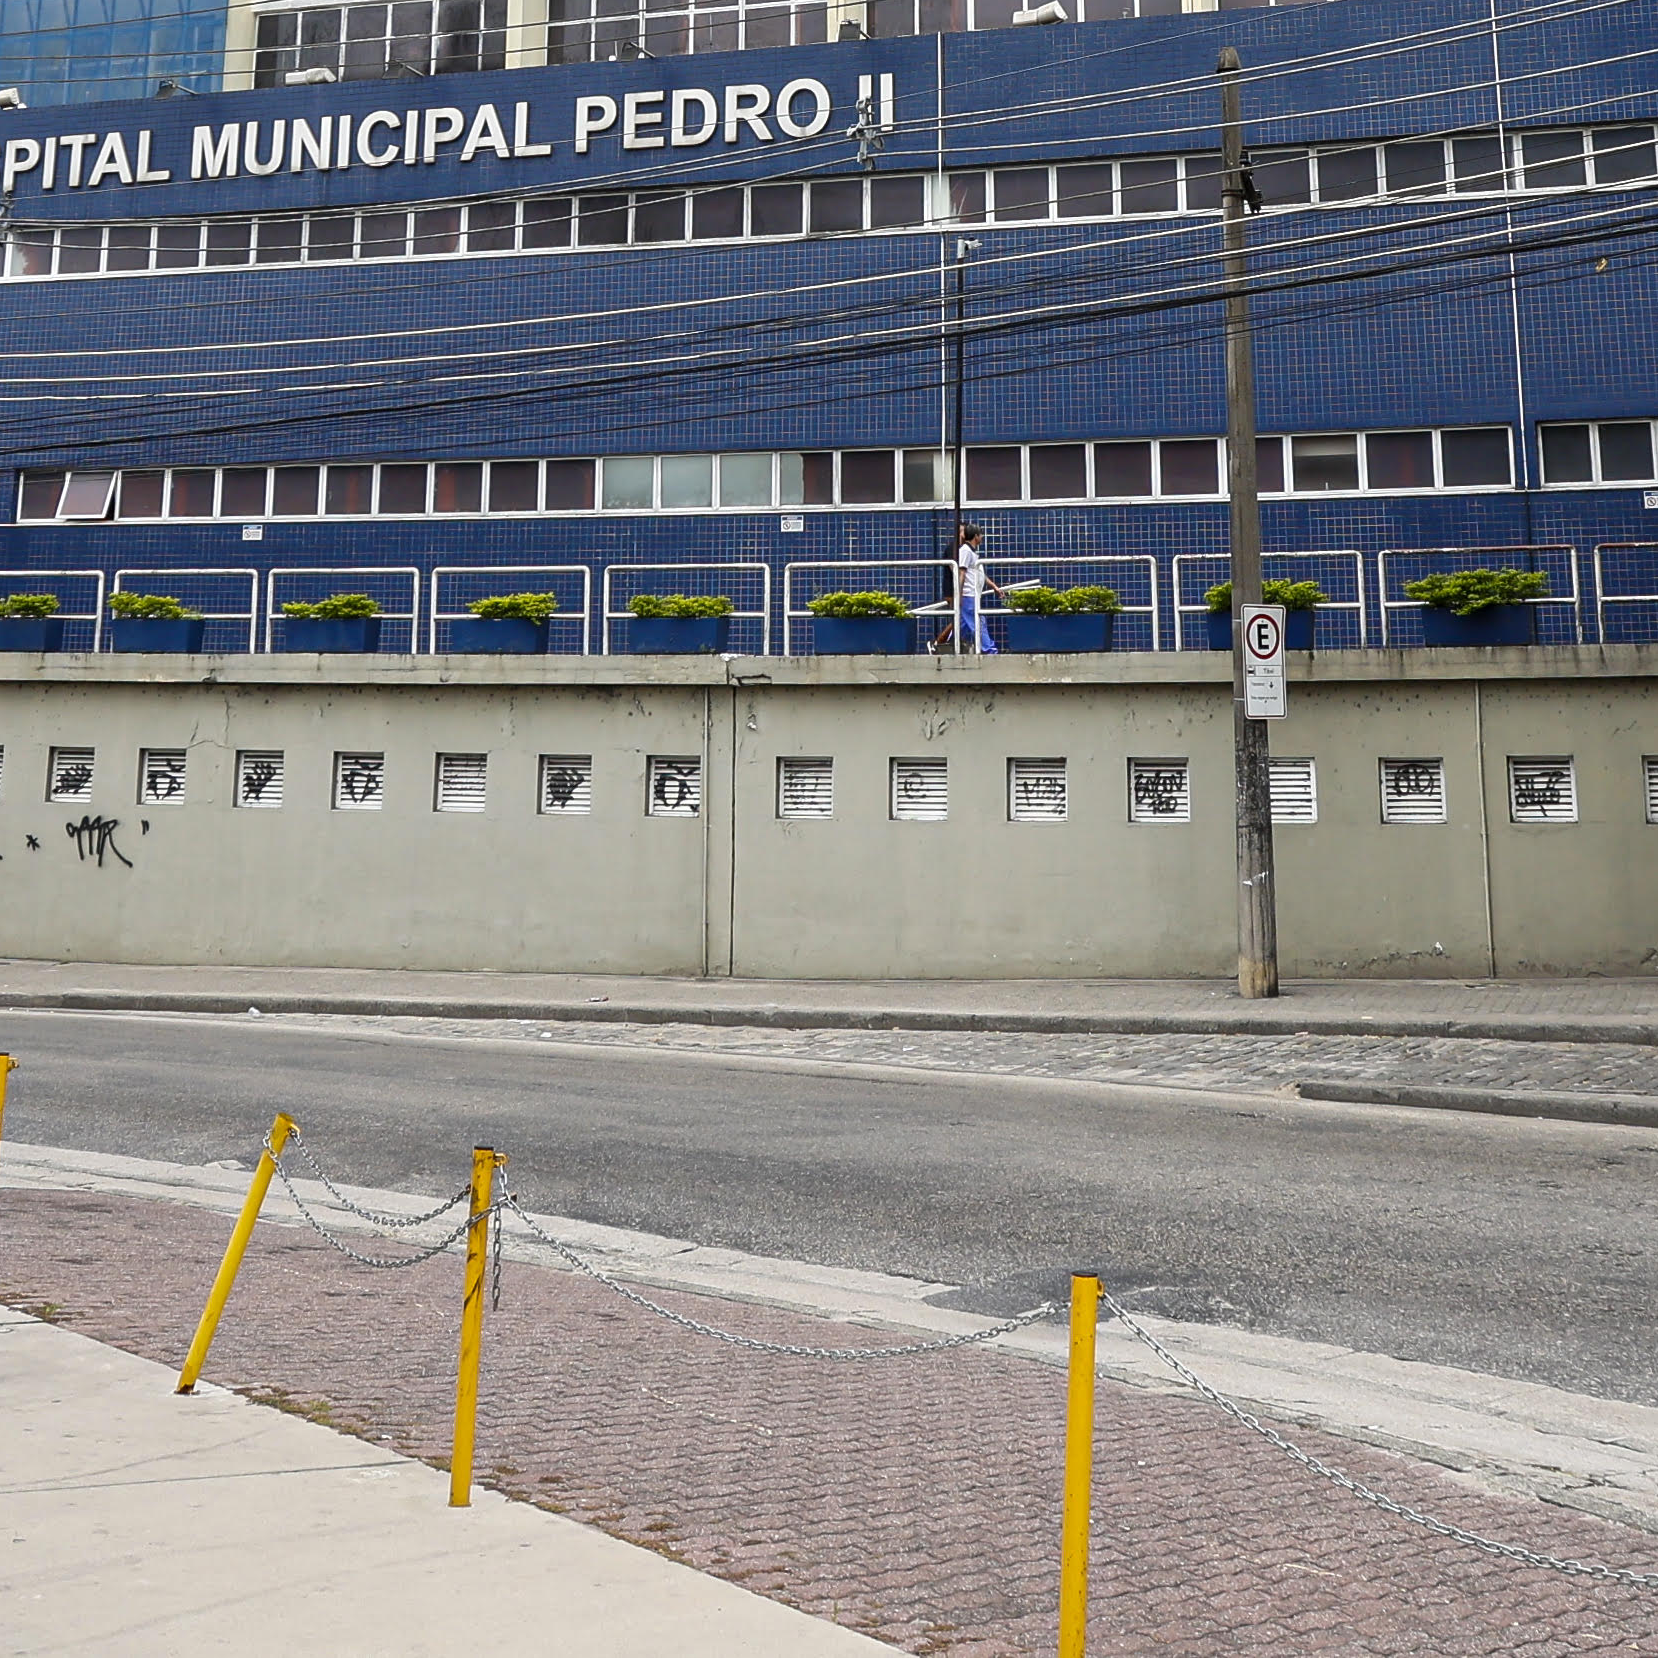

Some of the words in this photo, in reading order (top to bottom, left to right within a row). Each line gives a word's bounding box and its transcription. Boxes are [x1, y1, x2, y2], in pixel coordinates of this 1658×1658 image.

[191, 100, 552, 179] MUNICIPAL
[574, 78, 832, 154] PEDRO
[1257, 623, 1269, 649] E
